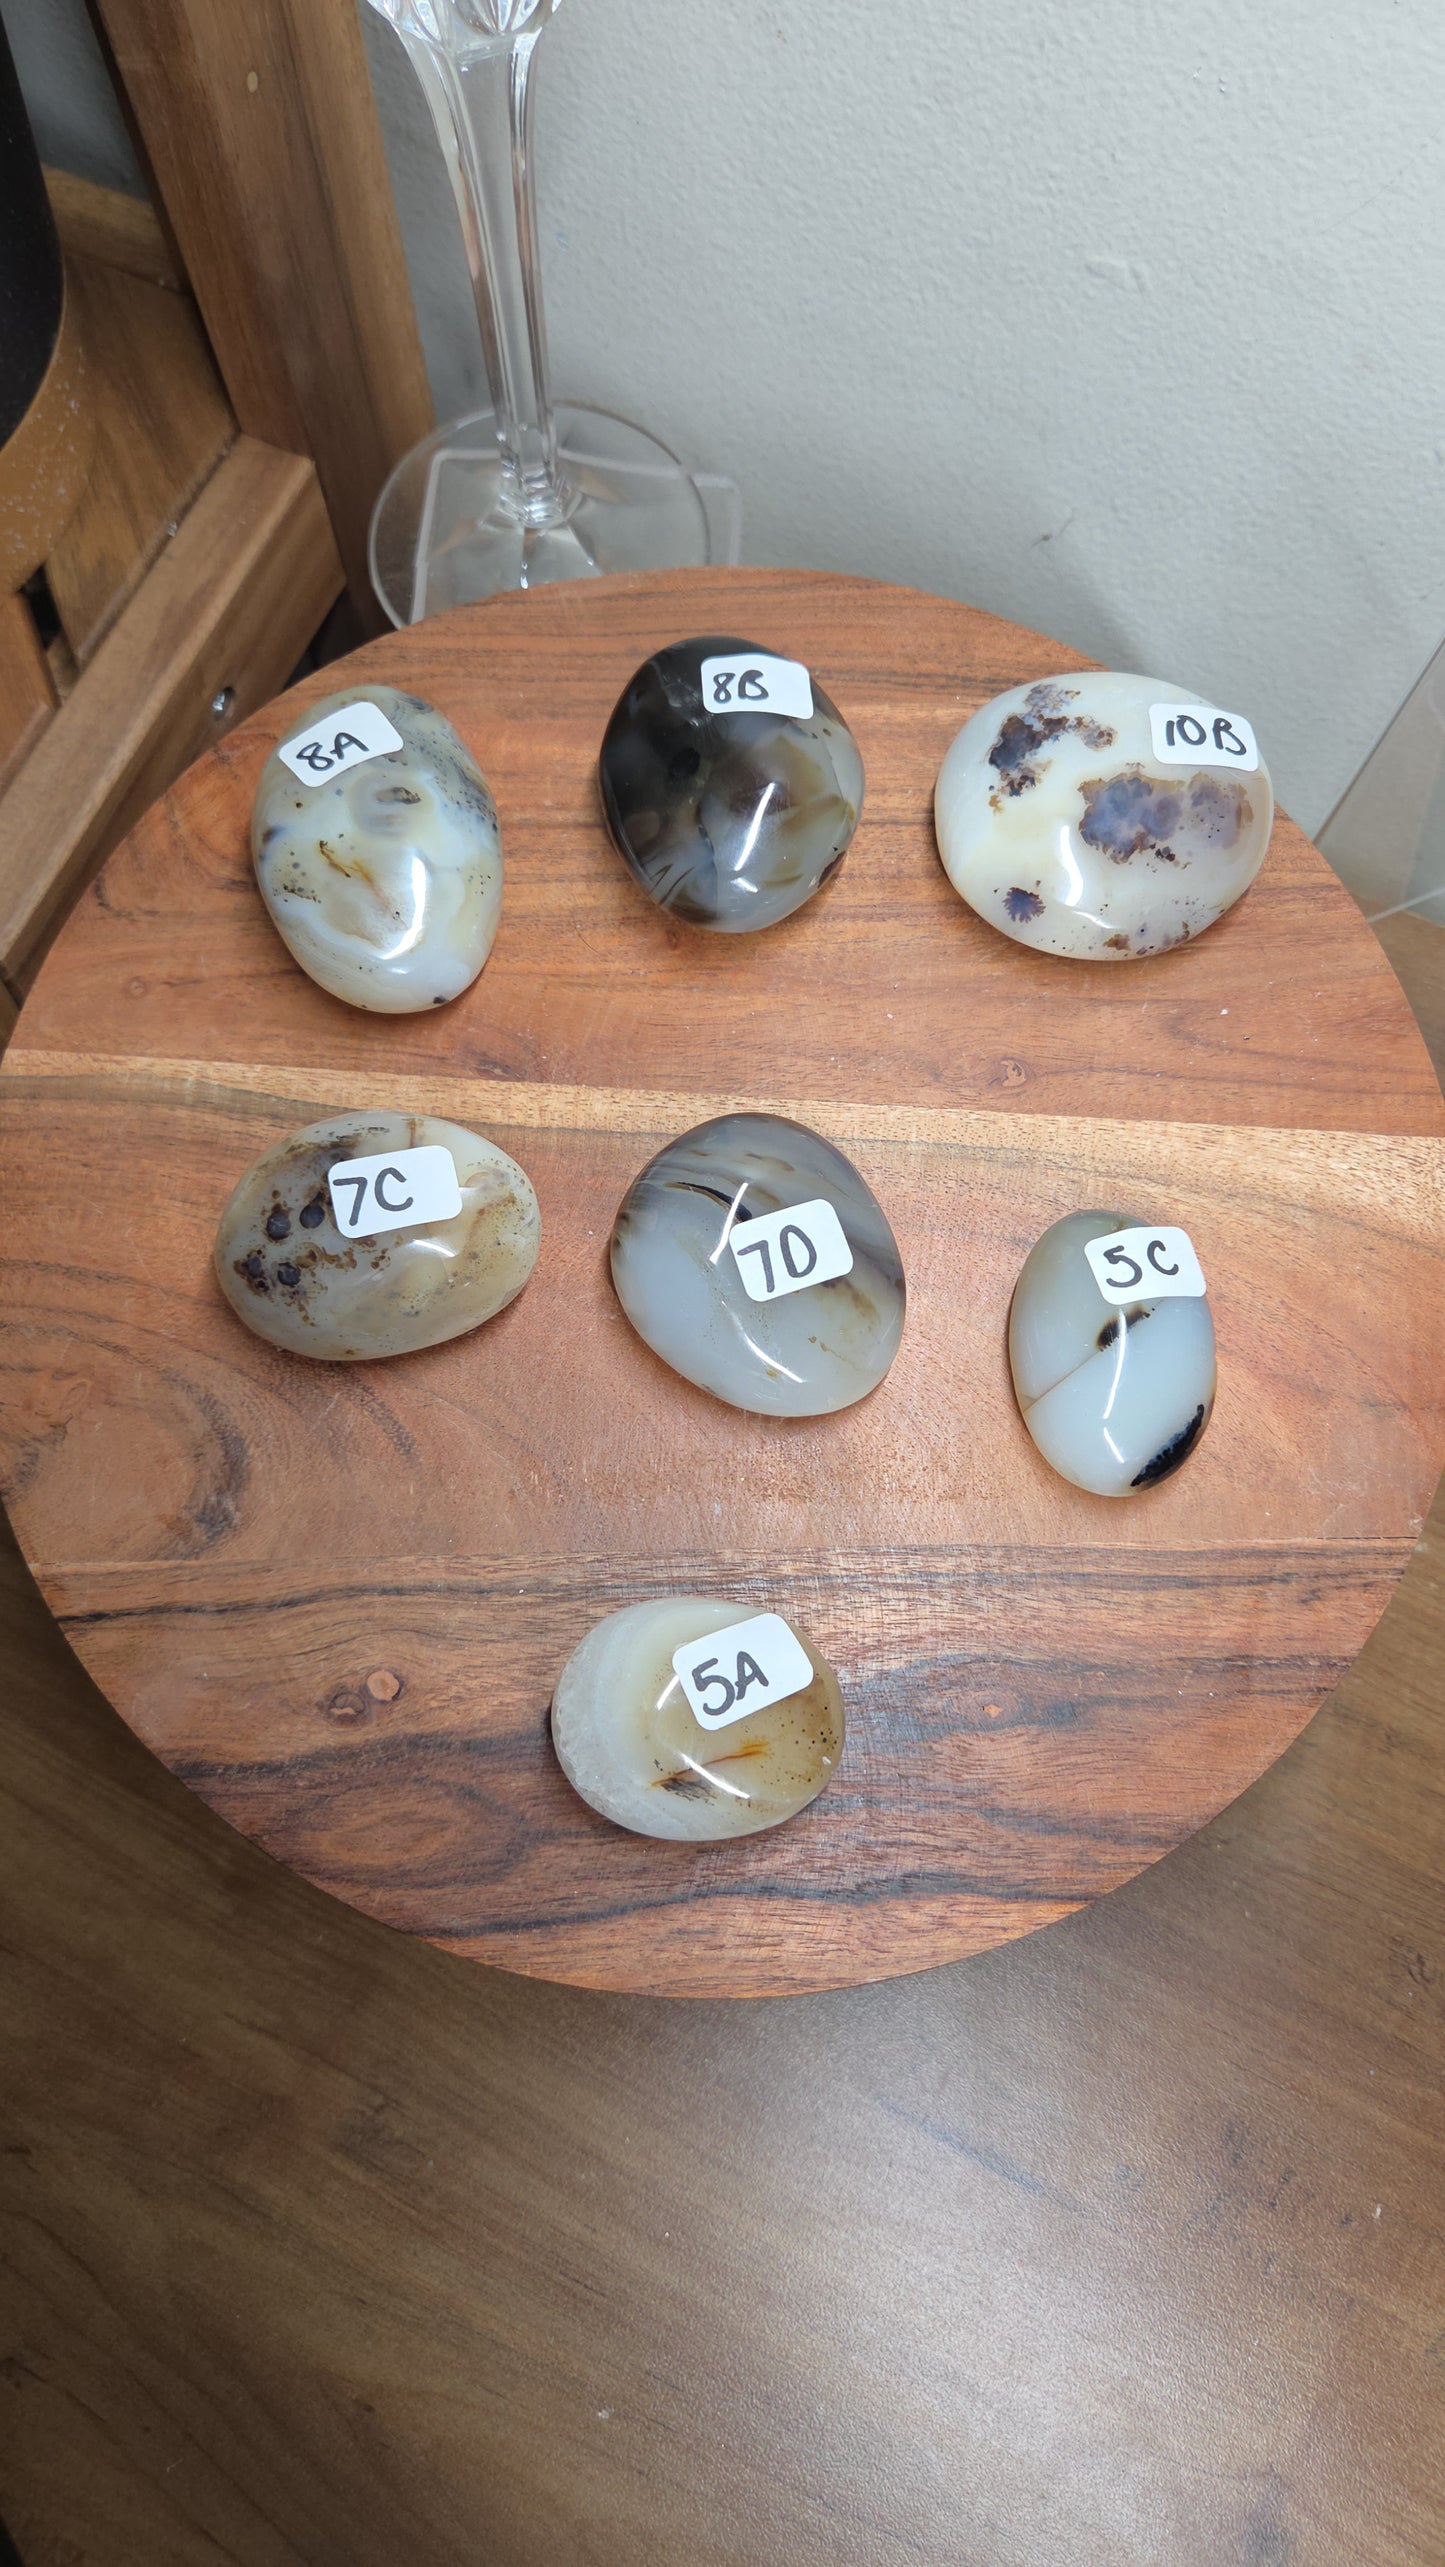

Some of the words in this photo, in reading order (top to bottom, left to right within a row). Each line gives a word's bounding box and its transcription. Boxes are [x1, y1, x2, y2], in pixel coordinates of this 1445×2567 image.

[713, 669, 769, 703] 8B
[295, 732, 369, 771] 8A
[1166, 714, 1247, 756] 10B
[332, 1167, 415, 1227] 7C
[736, 1224, 817, 1293] 7D
[1103, 1240, 1180, 1288] 5C
[691, 1651, 769, 1716] 5A
